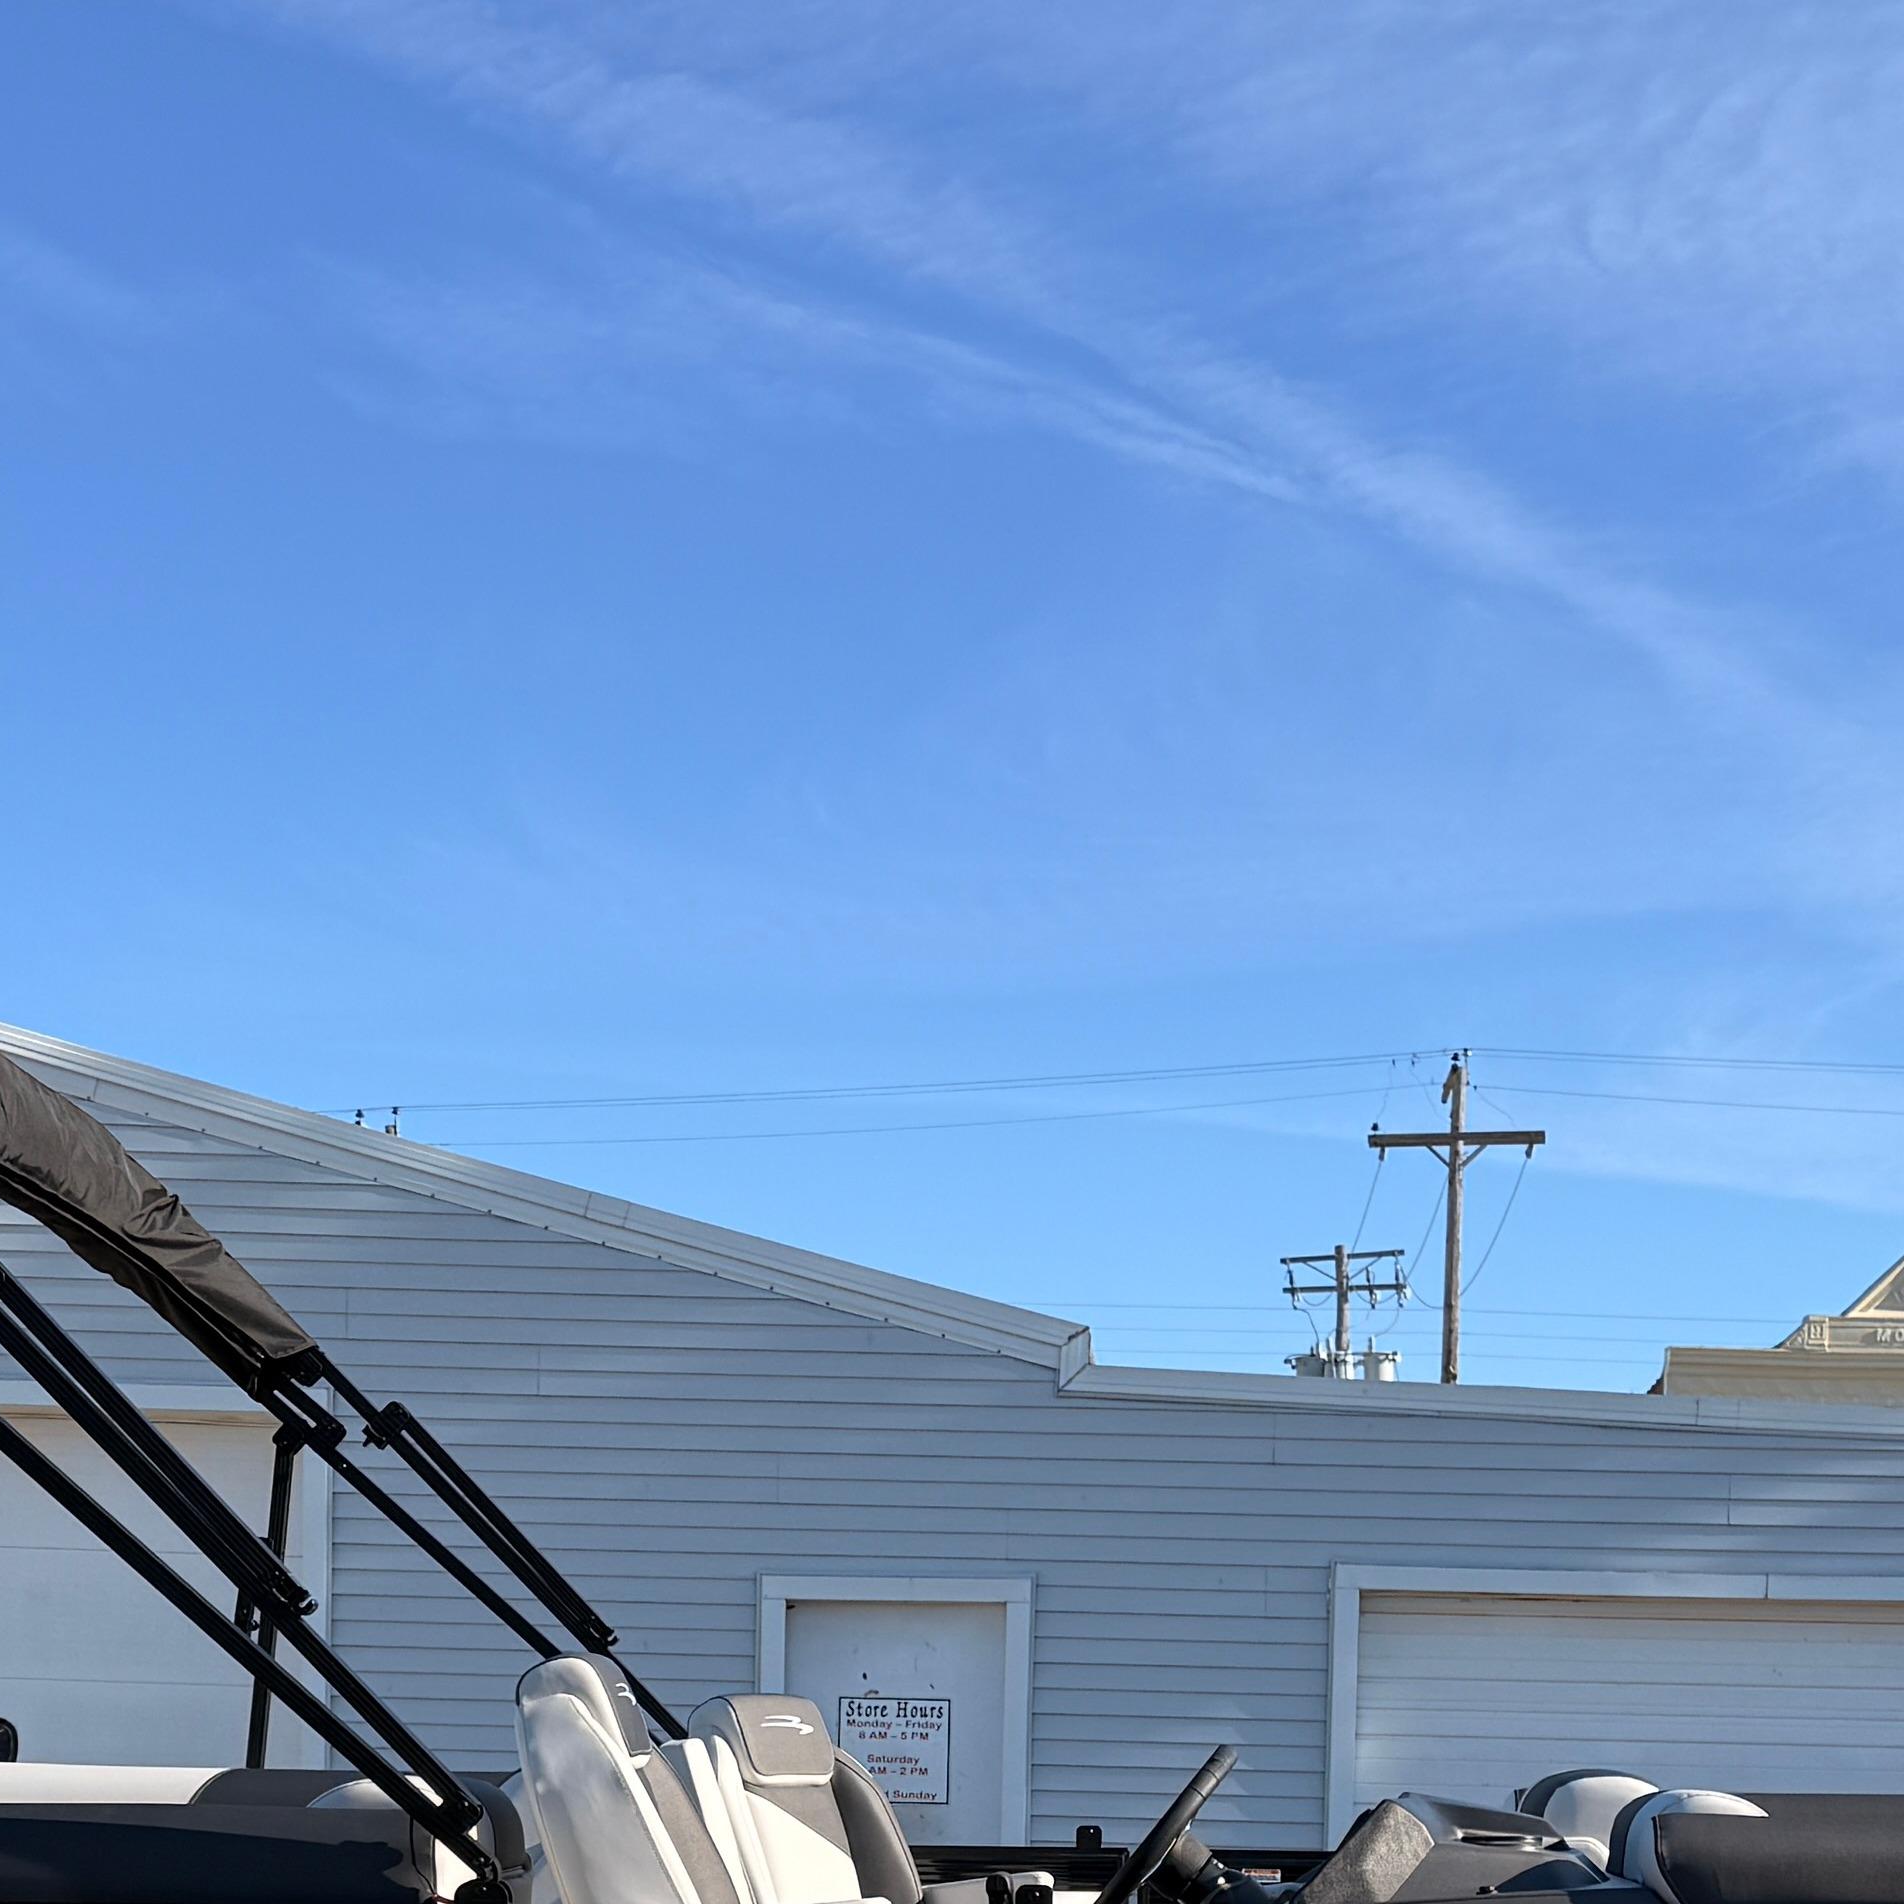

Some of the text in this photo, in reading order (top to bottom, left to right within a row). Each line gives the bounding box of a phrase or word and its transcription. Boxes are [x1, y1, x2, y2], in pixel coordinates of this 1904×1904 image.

[846, 1700, 944, 1719] Store Hours
[846, 1719, 893, 1729] Monday
[905, 1720, 942, 1730] Friday
[858, 1731, 866, 1739] 8
[869, 1731, 888, 1739] AM
[900, 1732, 907, 1740] 5
[911, 1732, 929, 1740] PM
[867, 1754, 920, 1766] Saturday
[869, 1766, 887, 1775] AM
[899, 1767, 907, 1775] 2
[910, 1767, 928, 1776] PM
[893, 1790, 937, 1800] Sunday
